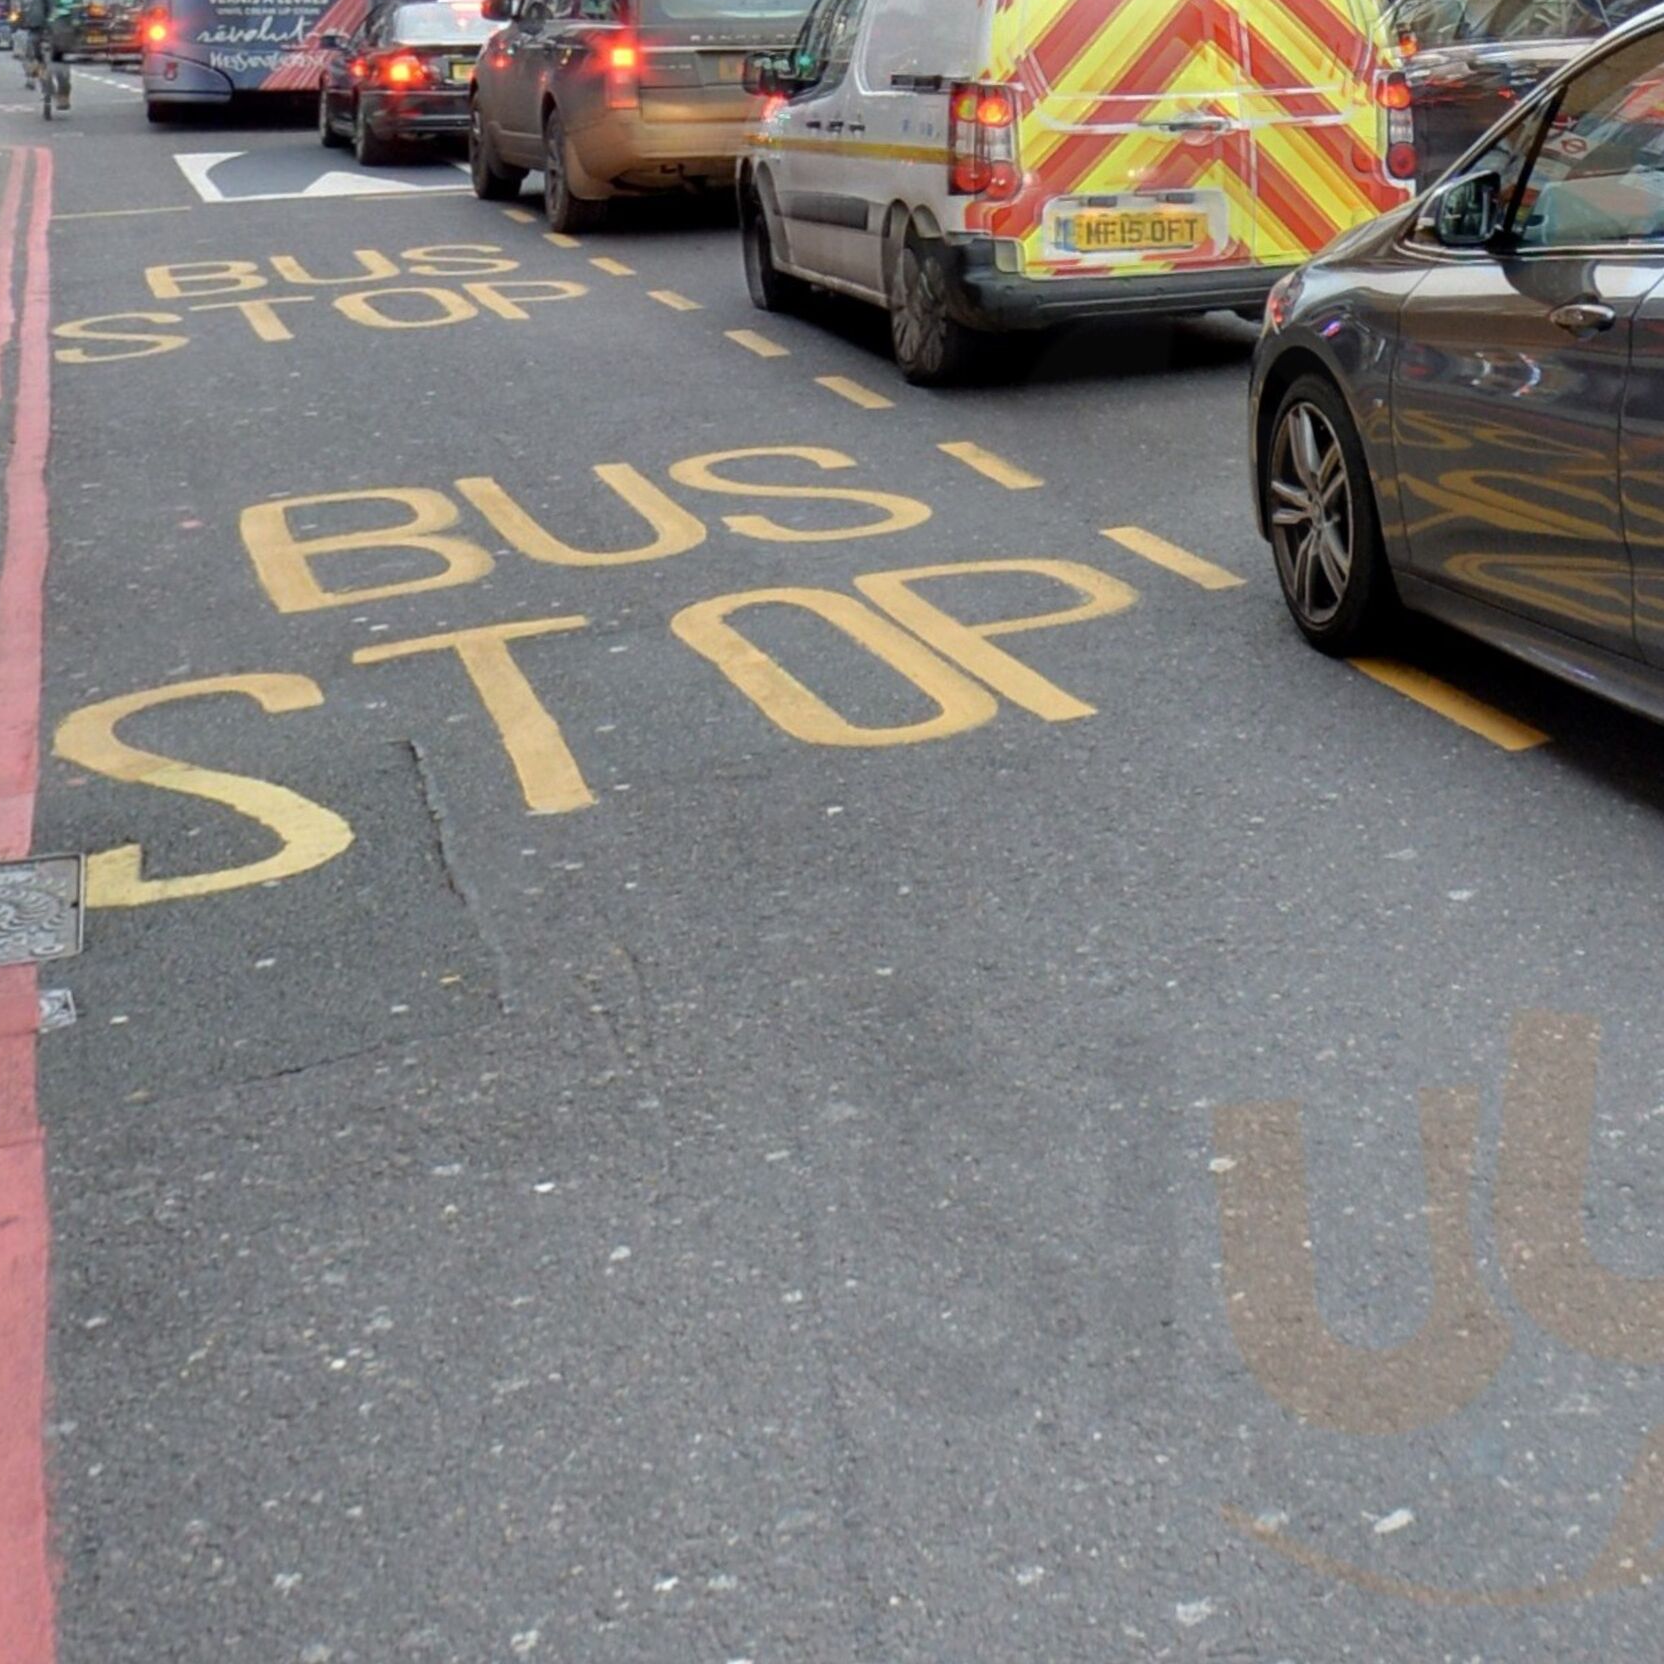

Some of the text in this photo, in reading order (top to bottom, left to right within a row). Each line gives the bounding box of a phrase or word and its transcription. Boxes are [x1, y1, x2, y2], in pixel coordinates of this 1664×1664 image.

[52, 279, 592, 365] STOP
[143, 242, 524, 302] BUS
[239, 443, 935, 615] BUS
[52, 554, 1141, 910] STOP
